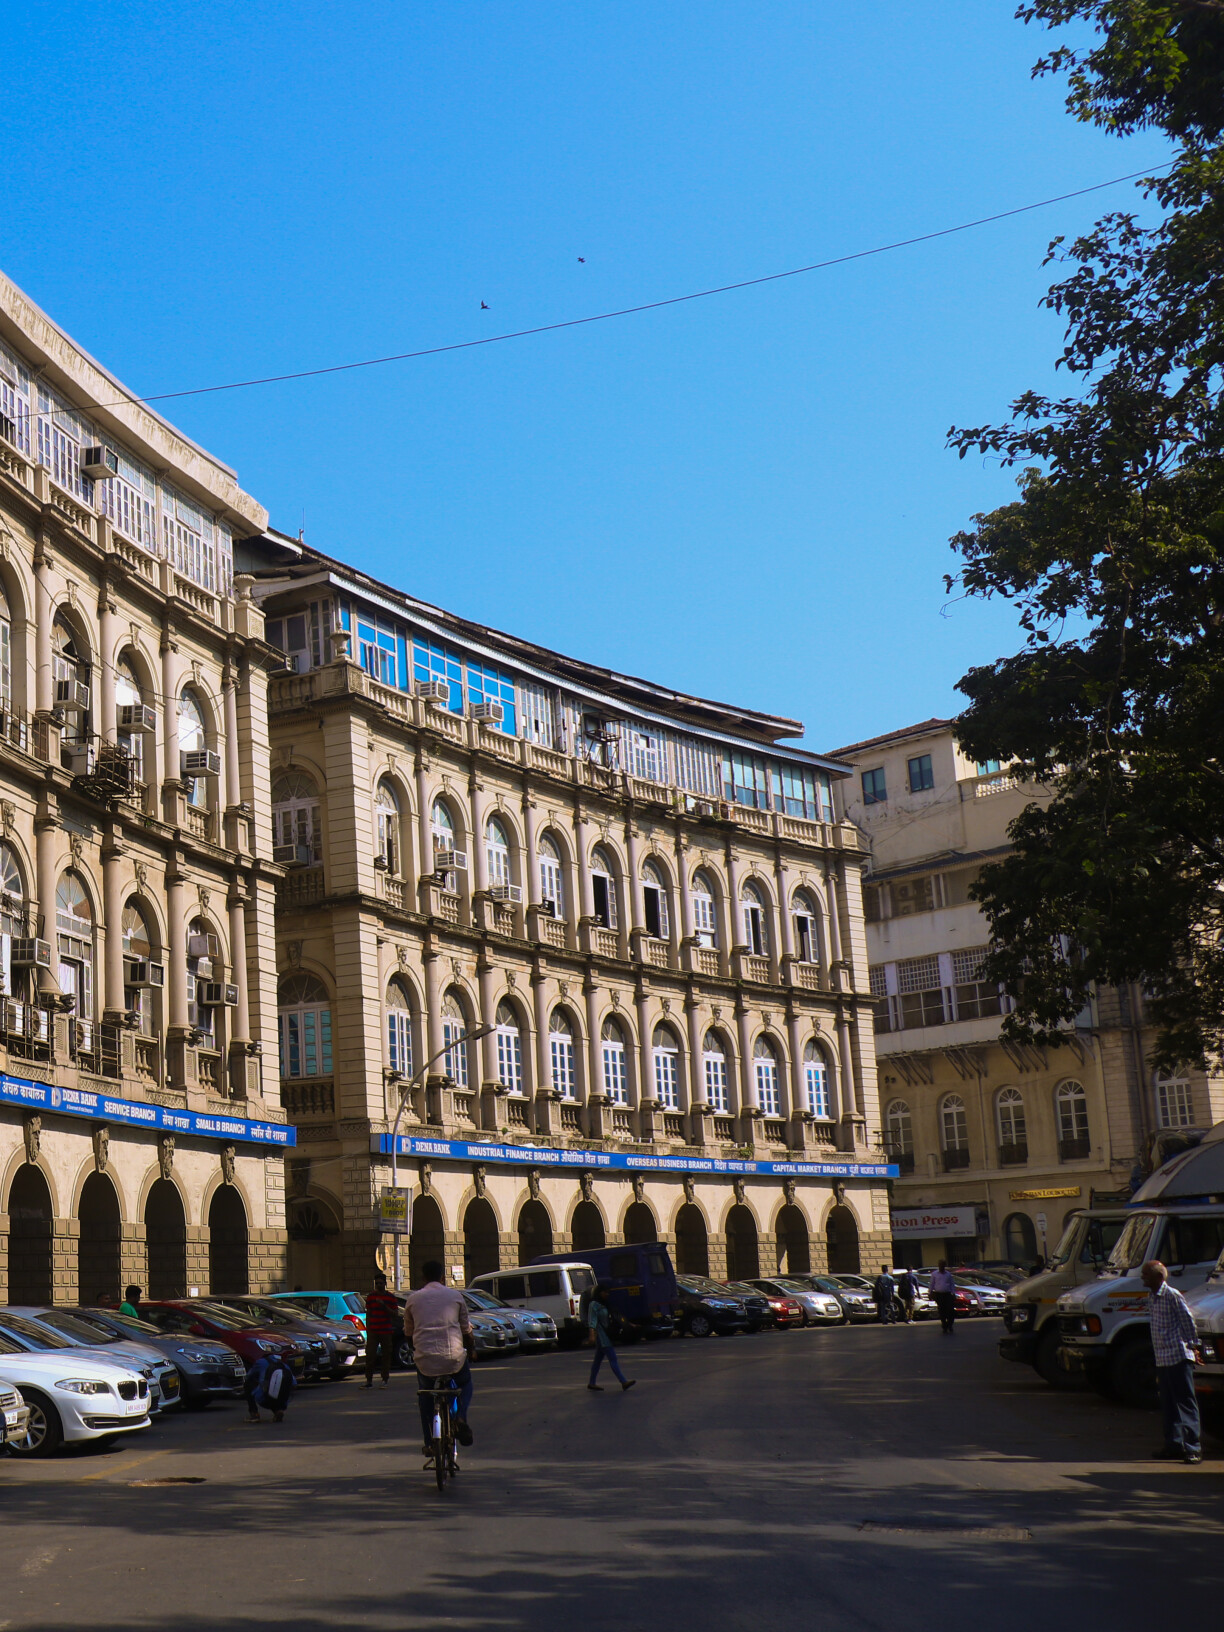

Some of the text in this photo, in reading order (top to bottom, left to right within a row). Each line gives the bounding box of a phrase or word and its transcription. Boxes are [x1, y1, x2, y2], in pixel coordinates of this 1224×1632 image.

[62, 1089, 98, 1107] DENA BANK
[104, 1101, 130, 1117] SERVICE
[130, 1106, 156, 1121] BRANCH
[195, 1118, 246, 1135] SMALL B BRANCH
[415, 1141, 451, 1155] DENA BANK
[467, 1145, 559, 1162] INDUSTRIAL FINANCE BRANCH
[626, 1157, 712, 1170] OVERSEAS BUSINESS BRANCH
[772, 1163, 847, 1174] CAPITAL MARKET BRANCH
[922, 1215, 959, 1226] Press
